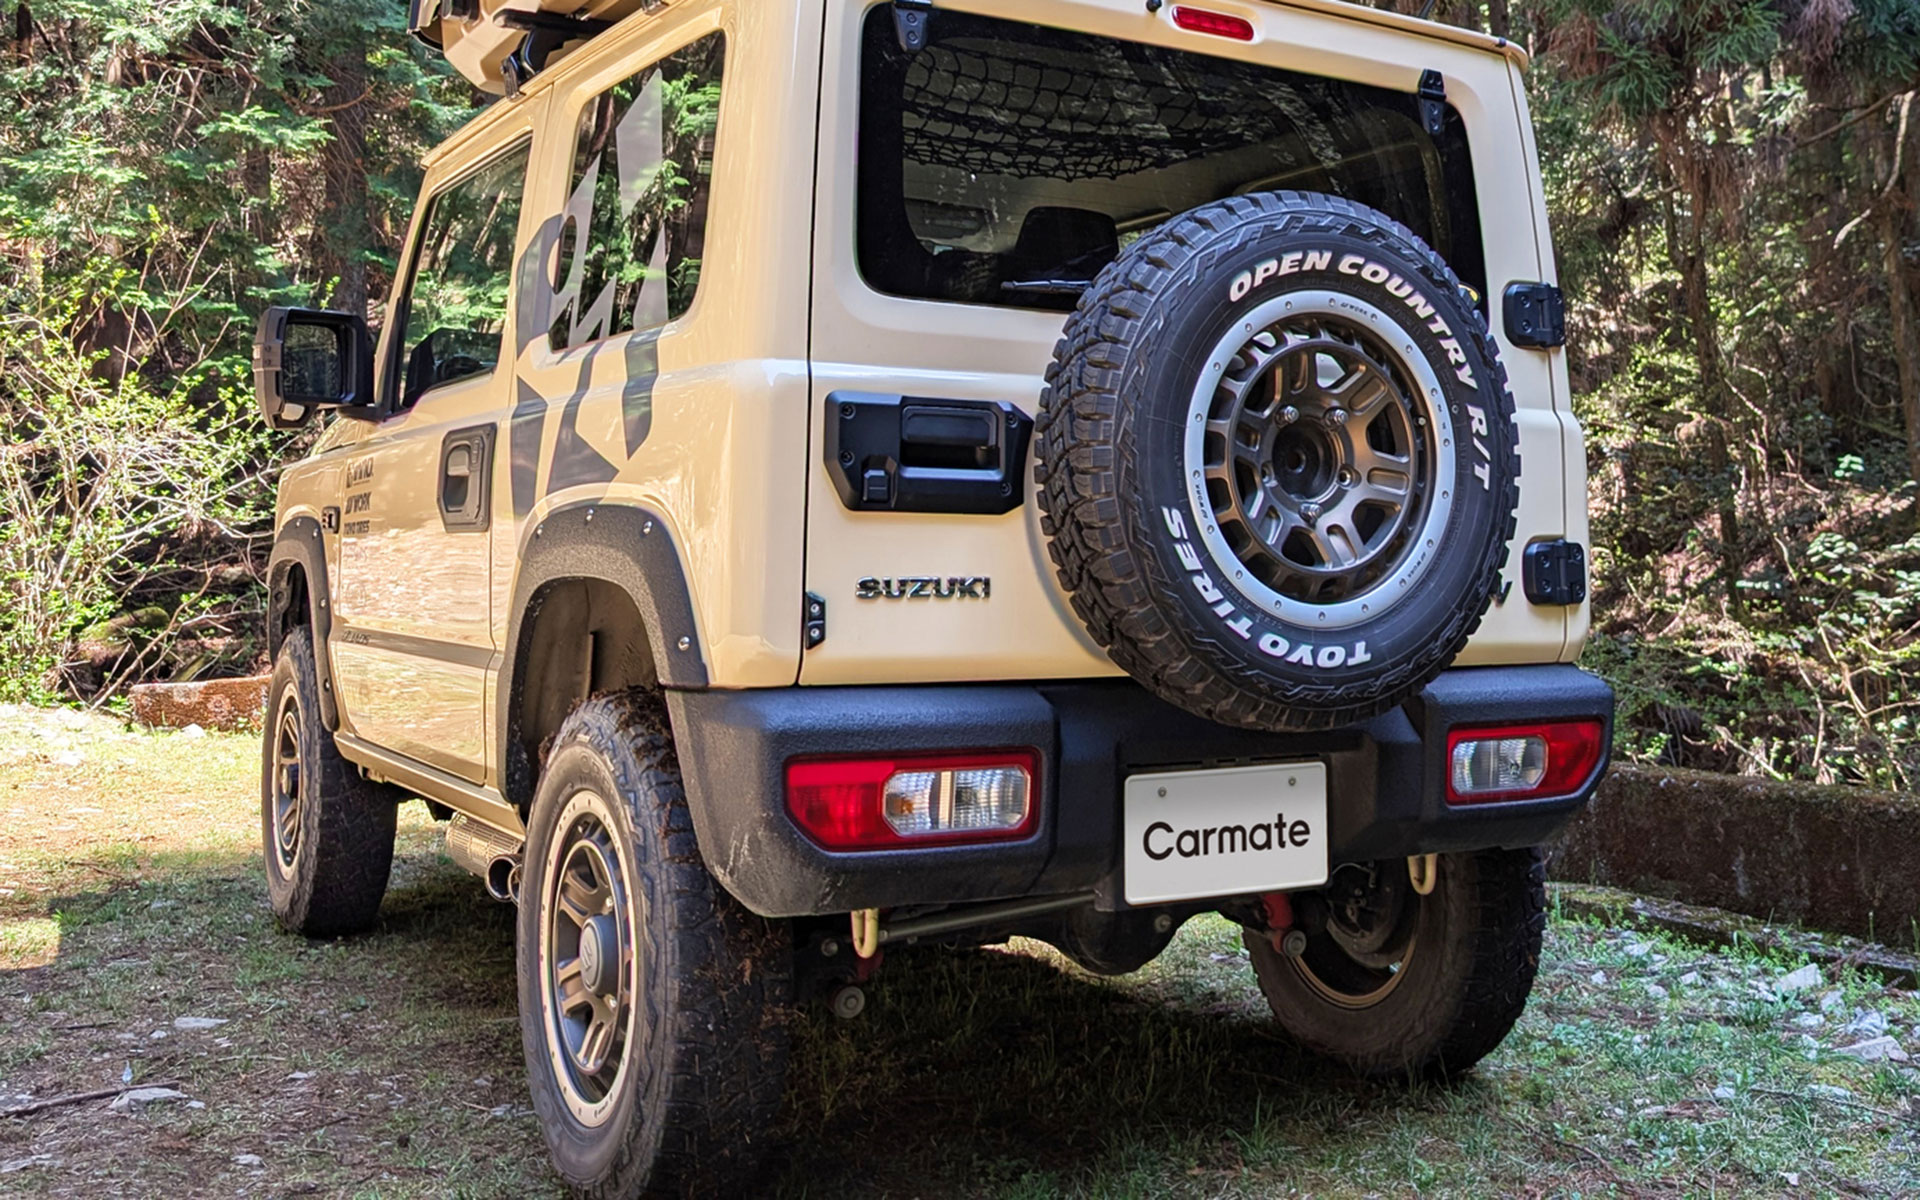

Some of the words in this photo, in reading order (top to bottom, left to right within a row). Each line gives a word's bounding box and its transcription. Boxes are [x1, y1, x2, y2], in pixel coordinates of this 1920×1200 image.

[1229, 251, 1332, 303] OPEN
[1338, 254, 1479, 390] COUNTRY
[1466, 404, 1491, 491] R/T
[855, 576, 991, 600] SUZUKI
[1162, 506, 1254, 640] TIRES
[1258, 633, 1372, 668] TOYO
[1143, 813, 1310, 860] Carmate
